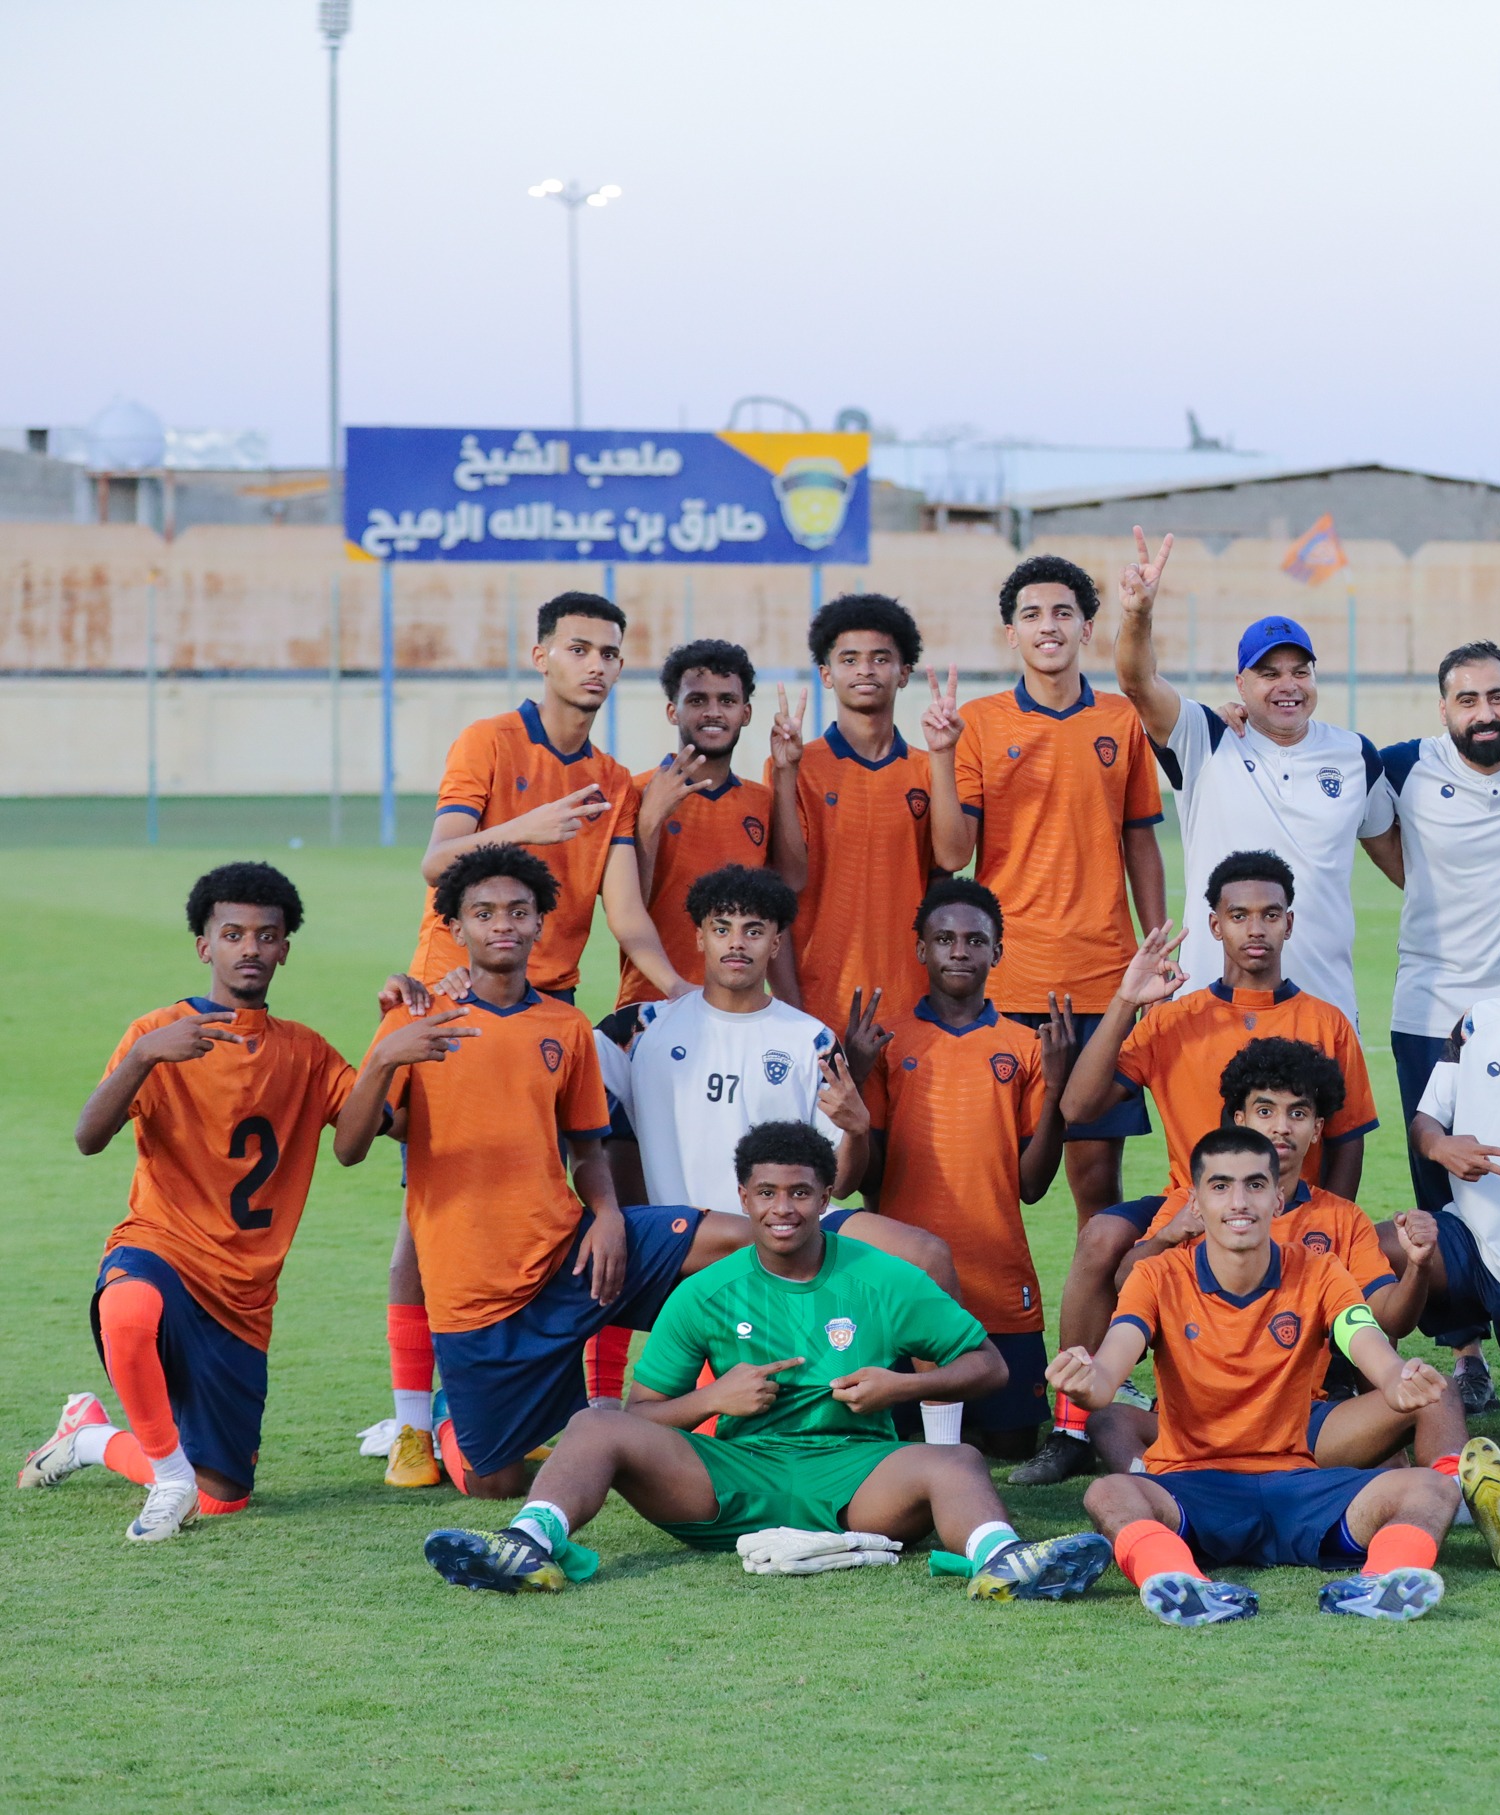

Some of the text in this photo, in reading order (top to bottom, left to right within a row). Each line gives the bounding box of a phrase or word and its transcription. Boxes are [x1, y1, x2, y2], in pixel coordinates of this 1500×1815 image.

[453, 430, 684, 492] ملعب الشيخ
[360, 498, 767, 558] طارق بن عبدالله الرميح
[706, 1073, 740, 1105] 97
[227, 1115, 280, 1231] 2
